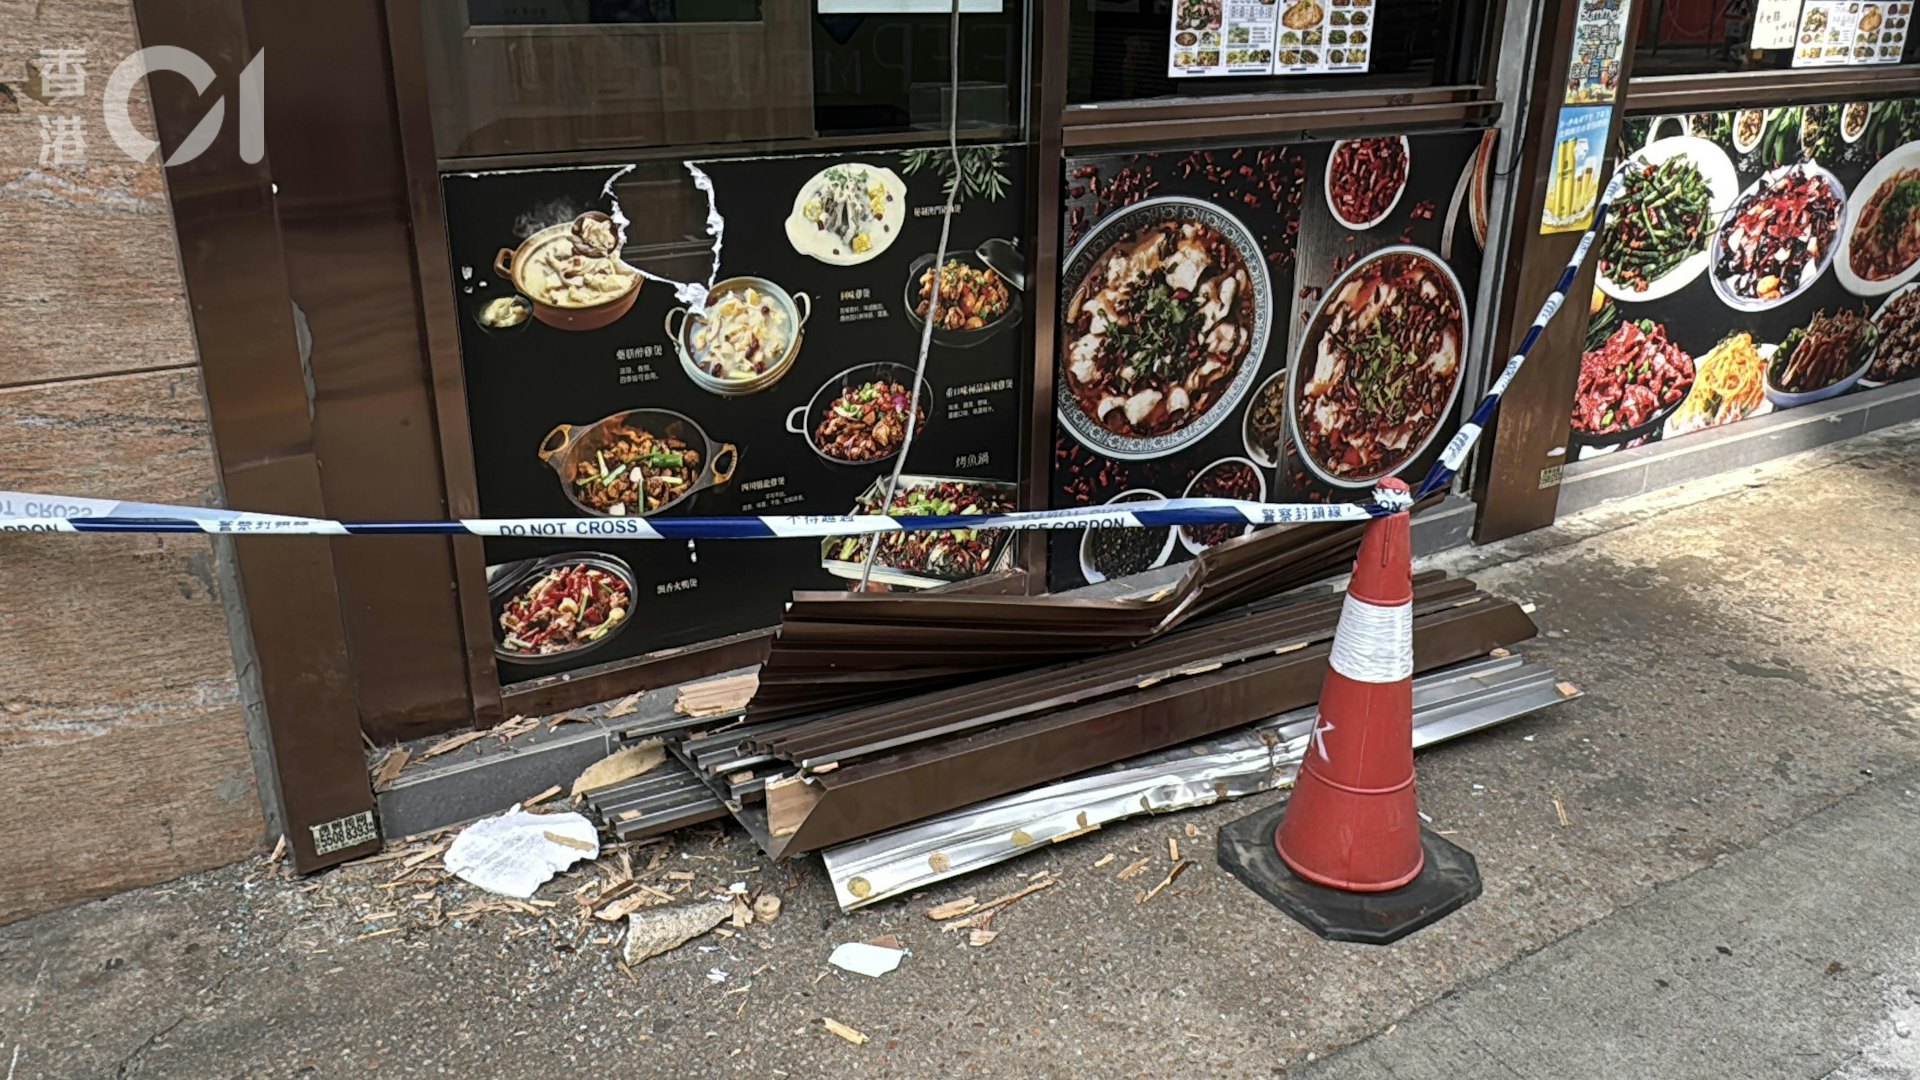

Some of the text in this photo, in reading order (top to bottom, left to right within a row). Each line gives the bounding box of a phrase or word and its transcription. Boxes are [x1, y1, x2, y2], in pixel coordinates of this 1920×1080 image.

[499, 519, 638, 536] DO NOT CROSS
[320, 829, 345, 848] 5508
[345, 822, 370, 841] 8393
